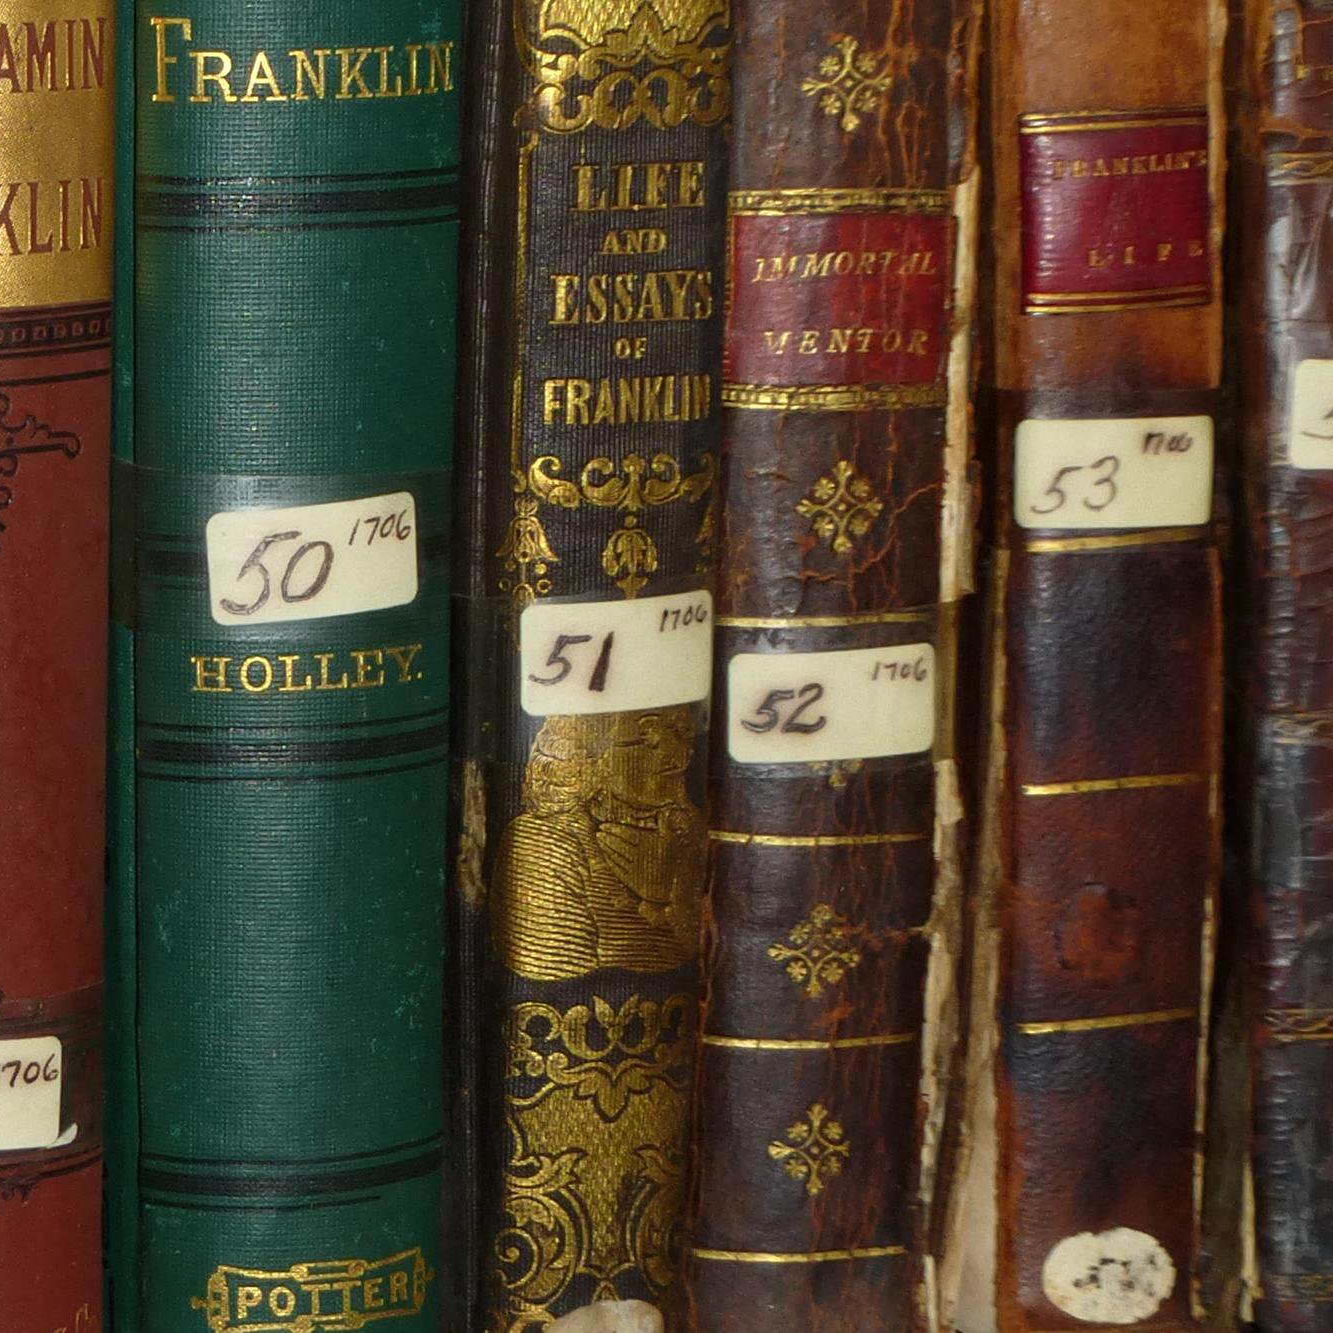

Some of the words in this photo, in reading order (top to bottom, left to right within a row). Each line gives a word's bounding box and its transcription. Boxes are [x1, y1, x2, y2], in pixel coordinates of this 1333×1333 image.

[151, 16, 455, 104] FRANKLIN
[569, 160, 707, 212] LIFE
[600, 228, 669, 256] AND
[751, 251, 938, 284] IMMORTAL
[547, 270, 714, 326] ESSAYS
[614, 336, 649, 360] OF
[542, 373, 712, 427] FRANKLIN
[1030, 454, 1121, 516] 53
[220, 529, 335, 616] 50
[348, 507, 412, 547] 1706
[190, 643, 425, 694] HOLLEY.
[528, 630, 615, 694] 51
[660, 602, 709, 634] 1706
[740, 682, 827, 735] 52
[871, 659, 928, 684] 1706
[236, 1270, 410, 1320] POTTER
